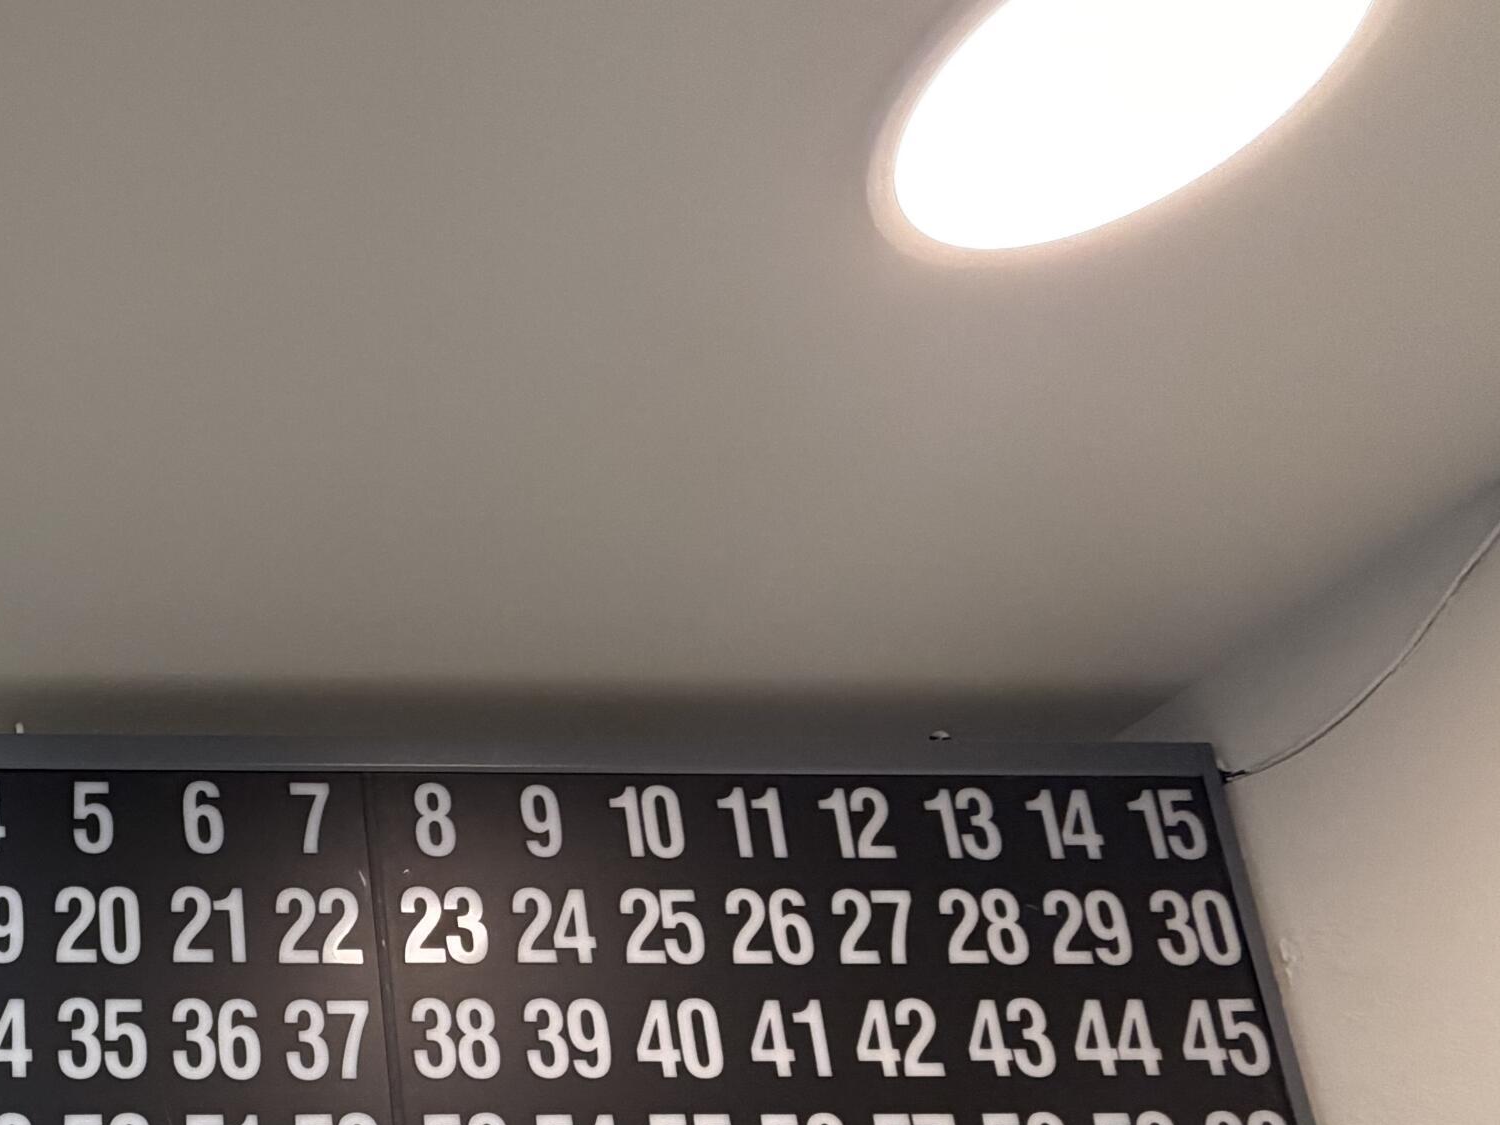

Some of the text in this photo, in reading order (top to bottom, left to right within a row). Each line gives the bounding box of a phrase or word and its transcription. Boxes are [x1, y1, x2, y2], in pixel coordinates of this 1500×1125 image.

[73, 782, 114, 854] 5
[183, 781, 224, 854] 6
[290, 783, 329, 854] 7
[414, 782, 457, 857] 8
[520, 784, 563, 858] 9
[609, 785, 685, 859] 10
[717, 787, 788, 858] 11
[818, 787, 897, 859] 12
[924, 788, 1002, 860] 13
[1026, 790, 1103, 859] 14
[1128, 790, 1206, 860] 15
[54, 886, 141, 965] 20
[170, 886, 247, 963] 21
[275, 887, 365, 965] 22
[400, 885, 490, 965] 23
[511, 886, 597, 964] 24
[619, 887, 706, 965] 25
[724, 887, 815, 966] 26
[831, 888, 912, 965] 27
[938, 888, 1029, 966] 28
[1043, 889, 1132, 966] 29
[1149, 889, 1241, 966] 30
[57, 997, 148, 1080] 35
[172, 997, 262, 1081] 36
[283, 998, 370, 1081] 37
[411, 997, 501, 1080] 38
[523, 997, 612, 1080] 39
[636, 997, 724, 1080] 40
[750, 999, 833, 1078] 41
[856, 997, 946, 1077] 42
[968, 997, 1057, 1078] 43
[1074, 999, 1163, 1076] 44
[1182, 998, 1271, 1077] 45
